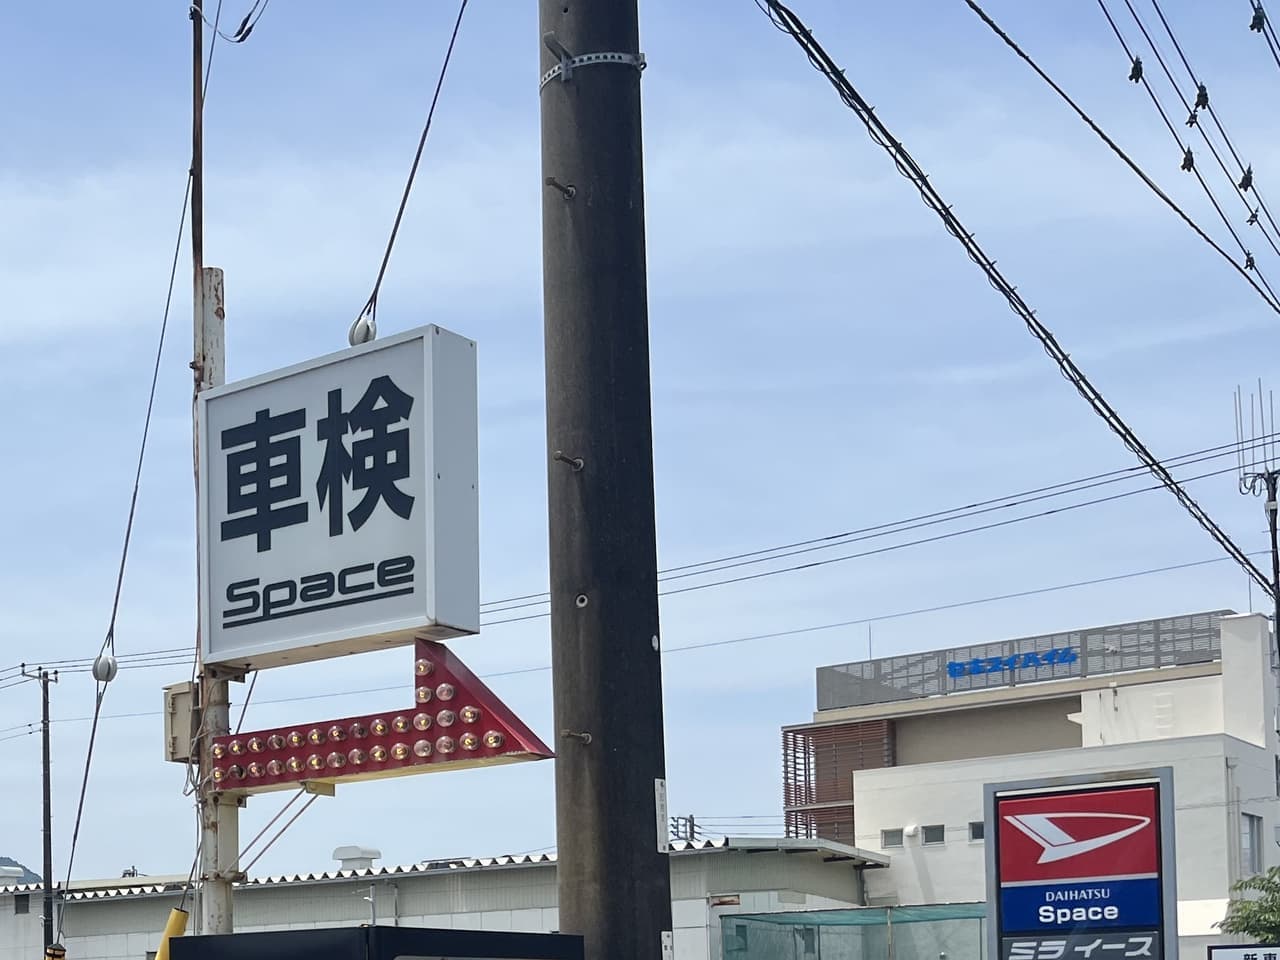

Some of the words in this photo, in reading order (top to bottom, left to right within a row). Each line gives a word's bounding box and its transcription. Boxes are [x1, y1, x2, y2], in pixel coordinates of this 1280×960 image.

[220, 375, 415, 553] 車検
[222, 555, 415, 625] Space
[1038, 905, 1119, 924] Space
[1045, 888, 1110, 902] DAIHATSU
